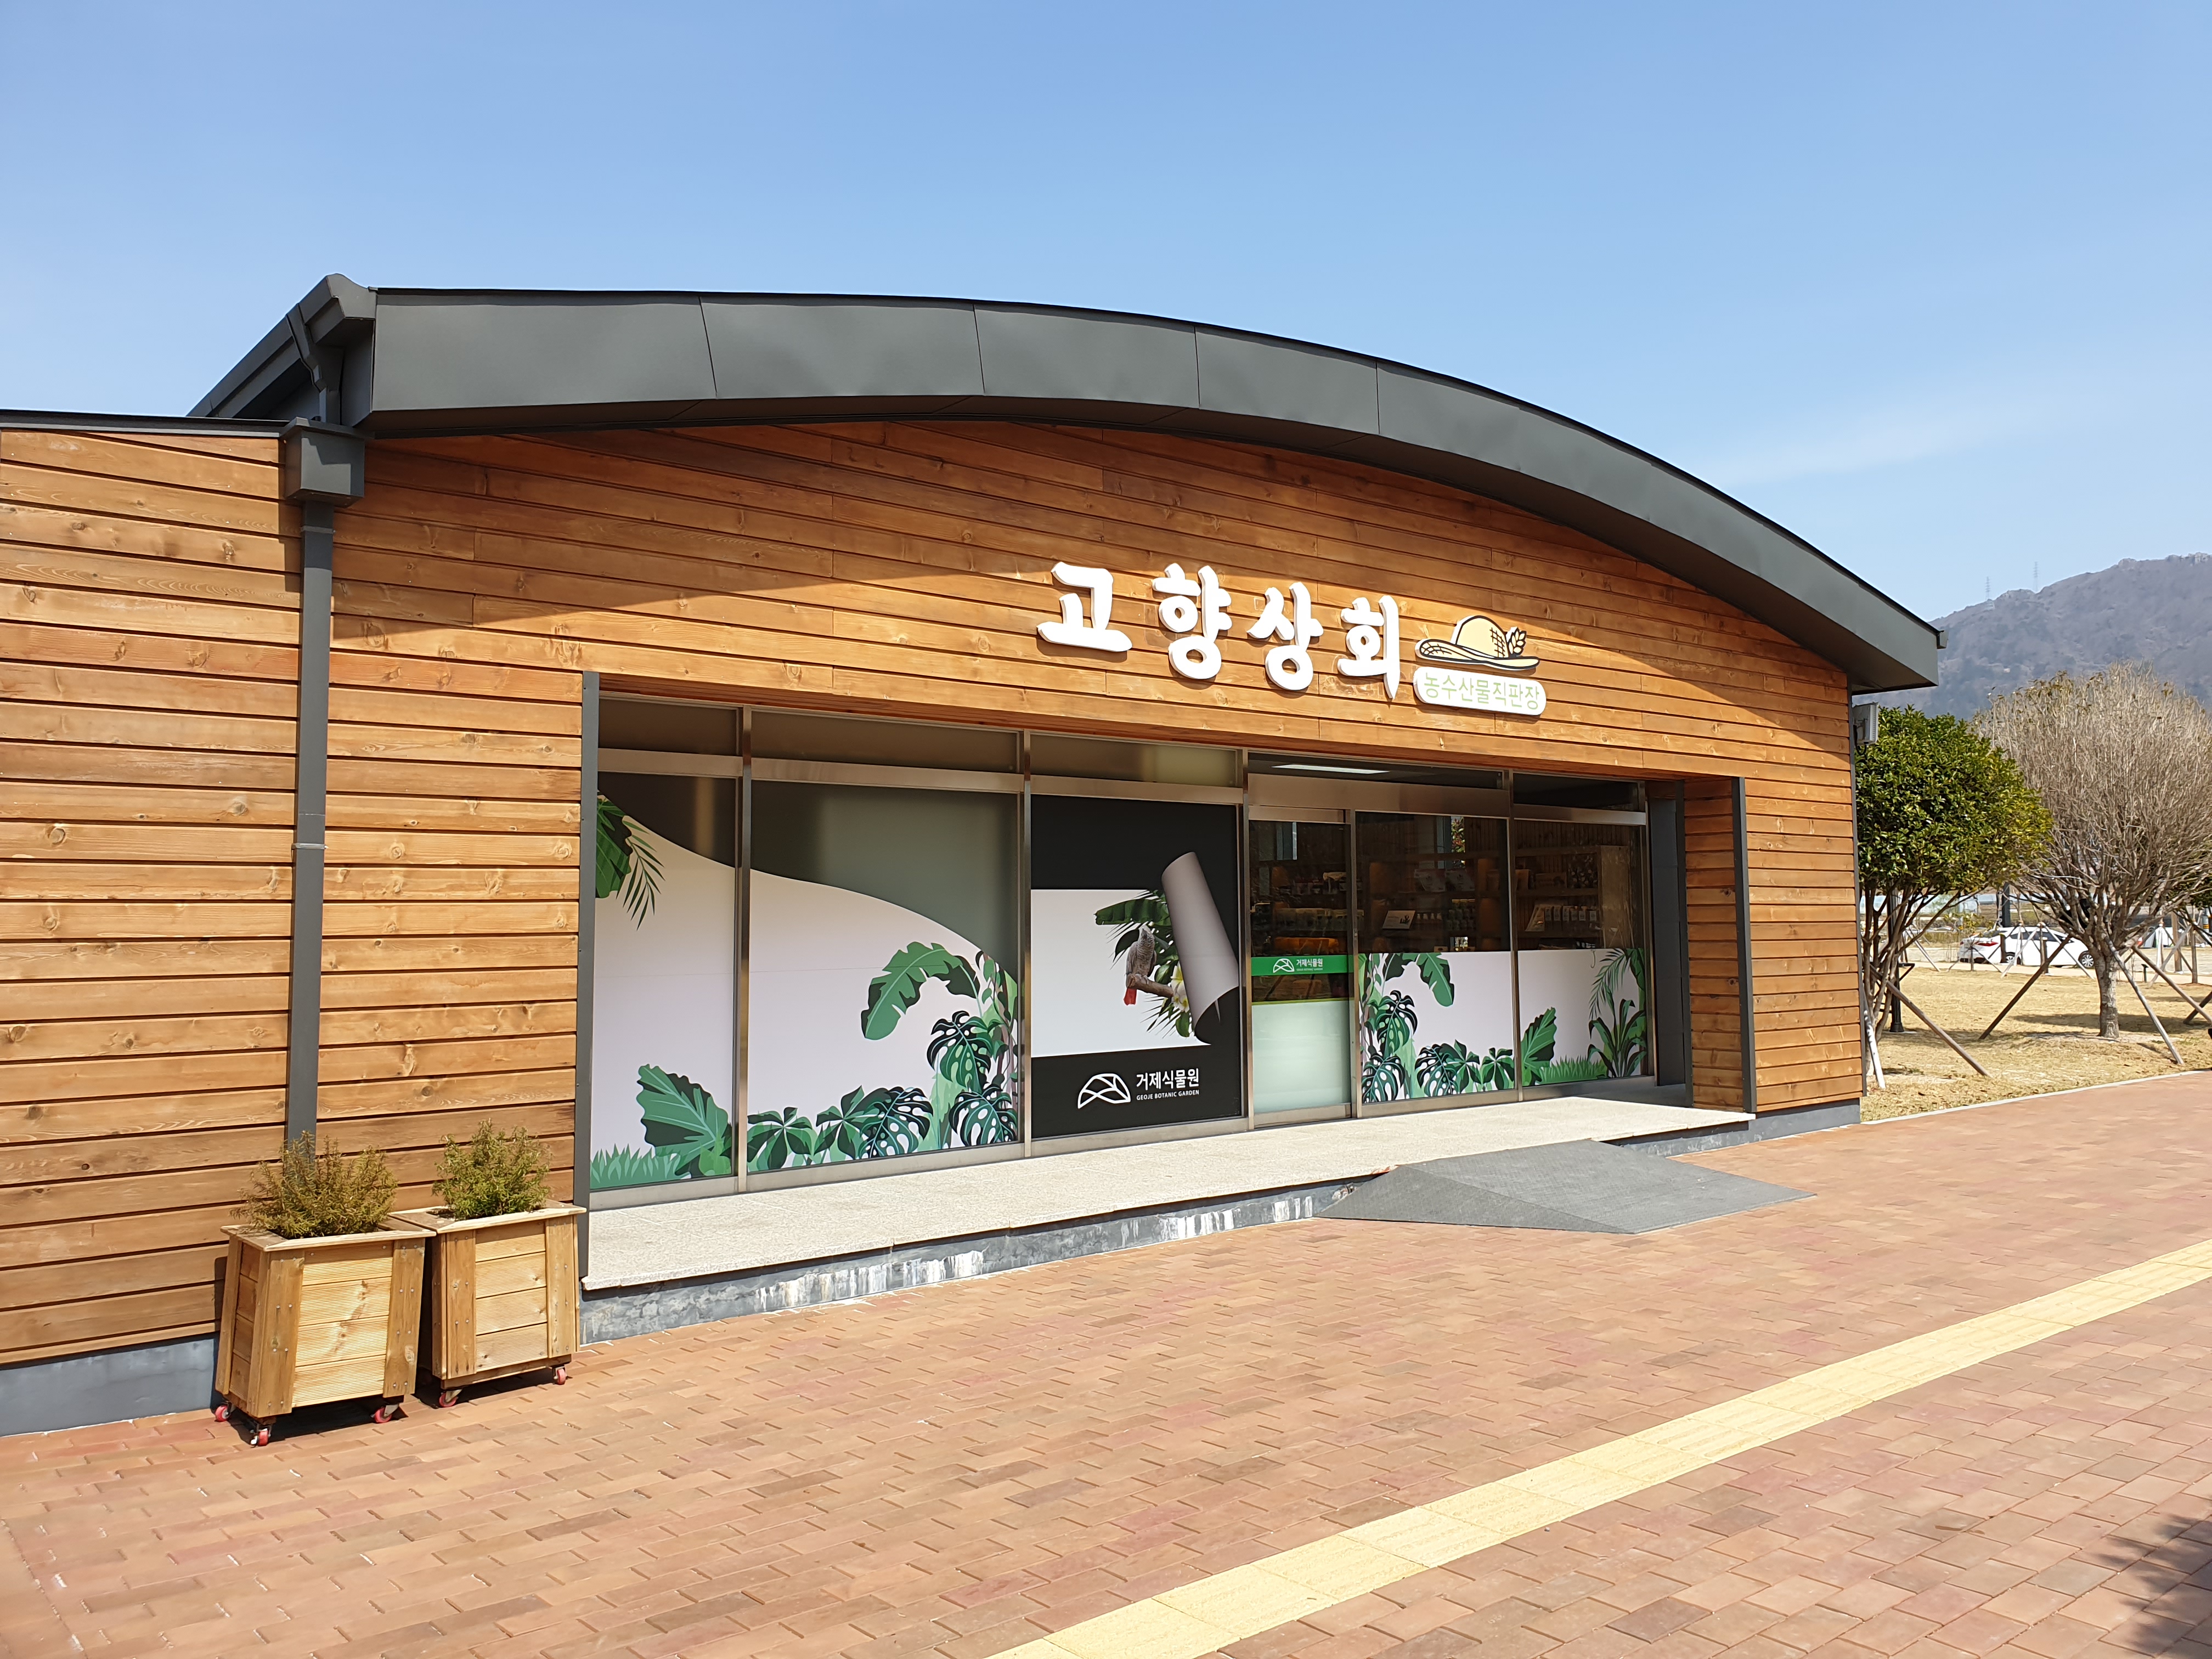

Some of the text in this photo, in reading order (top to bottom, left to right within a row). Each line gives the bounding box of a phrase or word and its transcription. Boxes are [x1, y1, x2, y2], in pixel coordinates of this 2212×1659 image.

[1037, 561, 1401, 700] 고향상회
[1424, 672, 1539, 710] 농수산물직판장
[1136, 1068, 1199, 1091] 거제식물원
